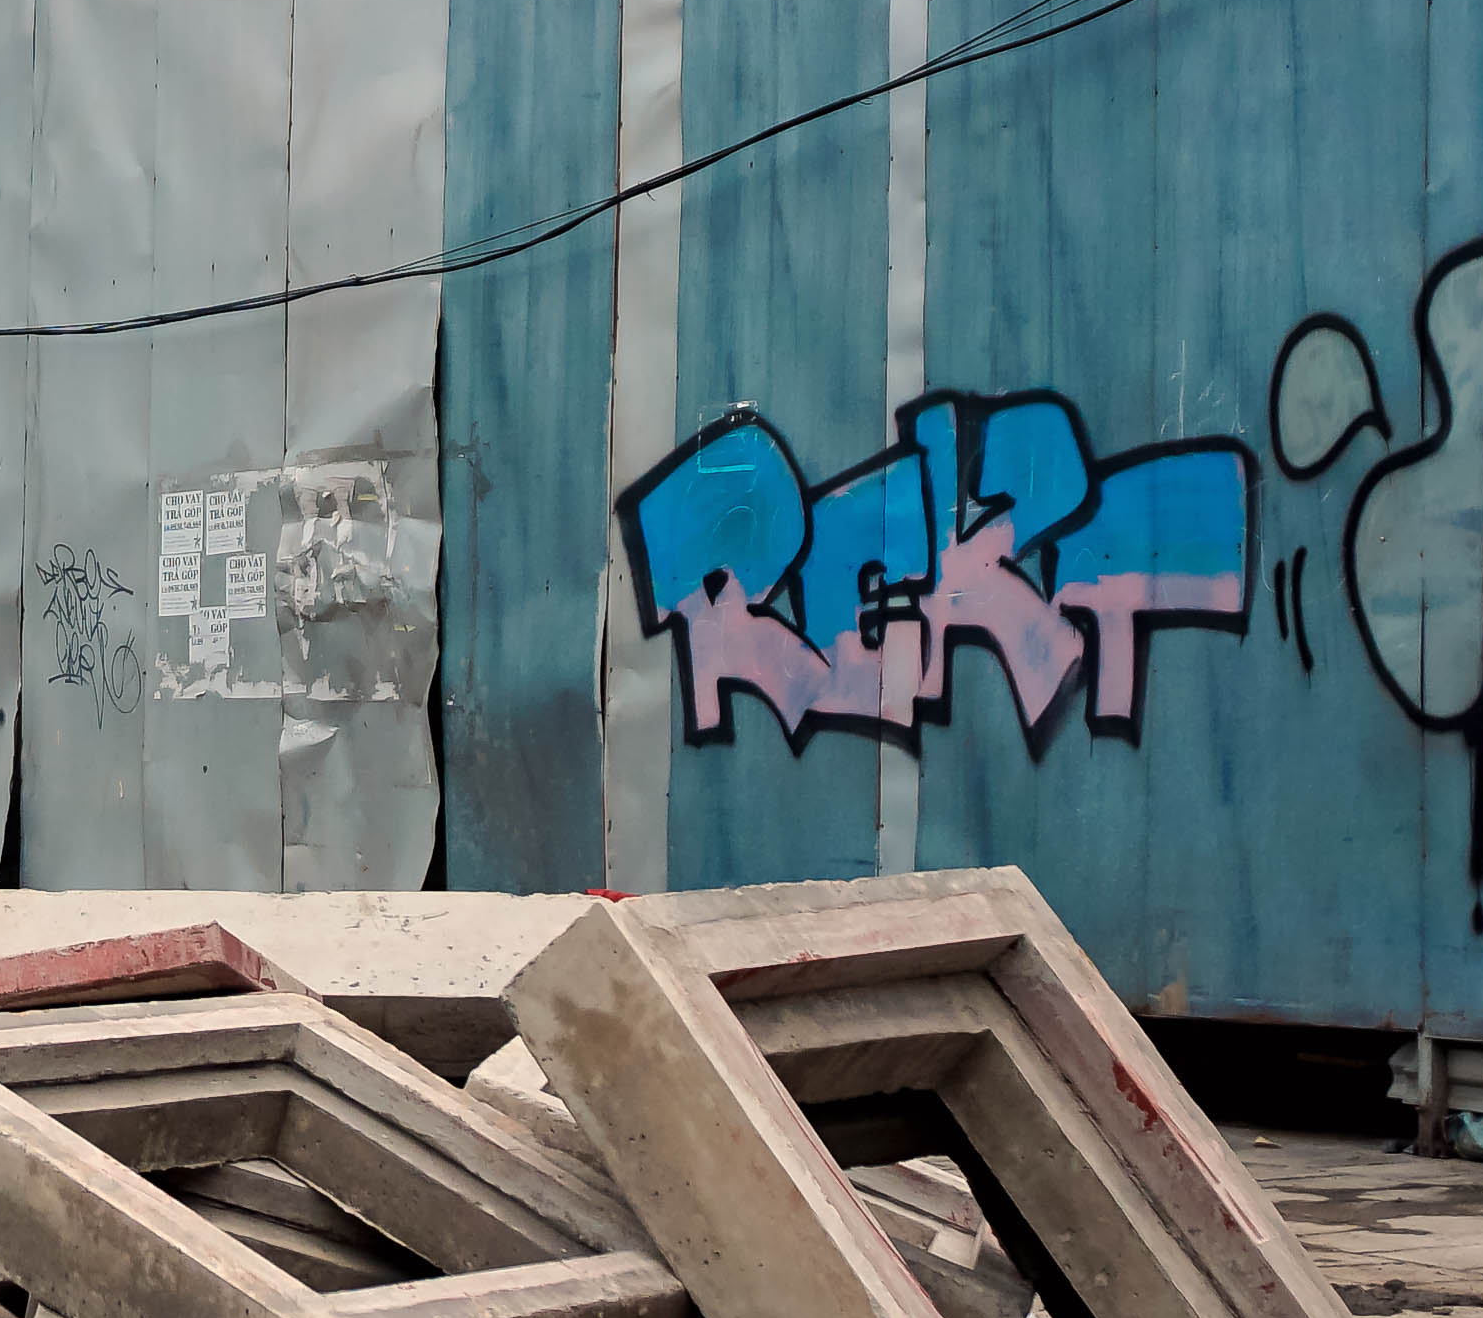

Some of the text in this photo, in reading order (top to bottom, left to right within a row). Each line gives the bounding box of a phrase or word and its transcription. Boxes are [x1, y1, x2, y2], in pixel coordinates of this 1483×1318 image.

[185, 492, 202, 504] VAY
[227, 491, 243, 504] VAY
[182, 554, 199, 566] VAY
[248, 556, 265, 568] VAY
